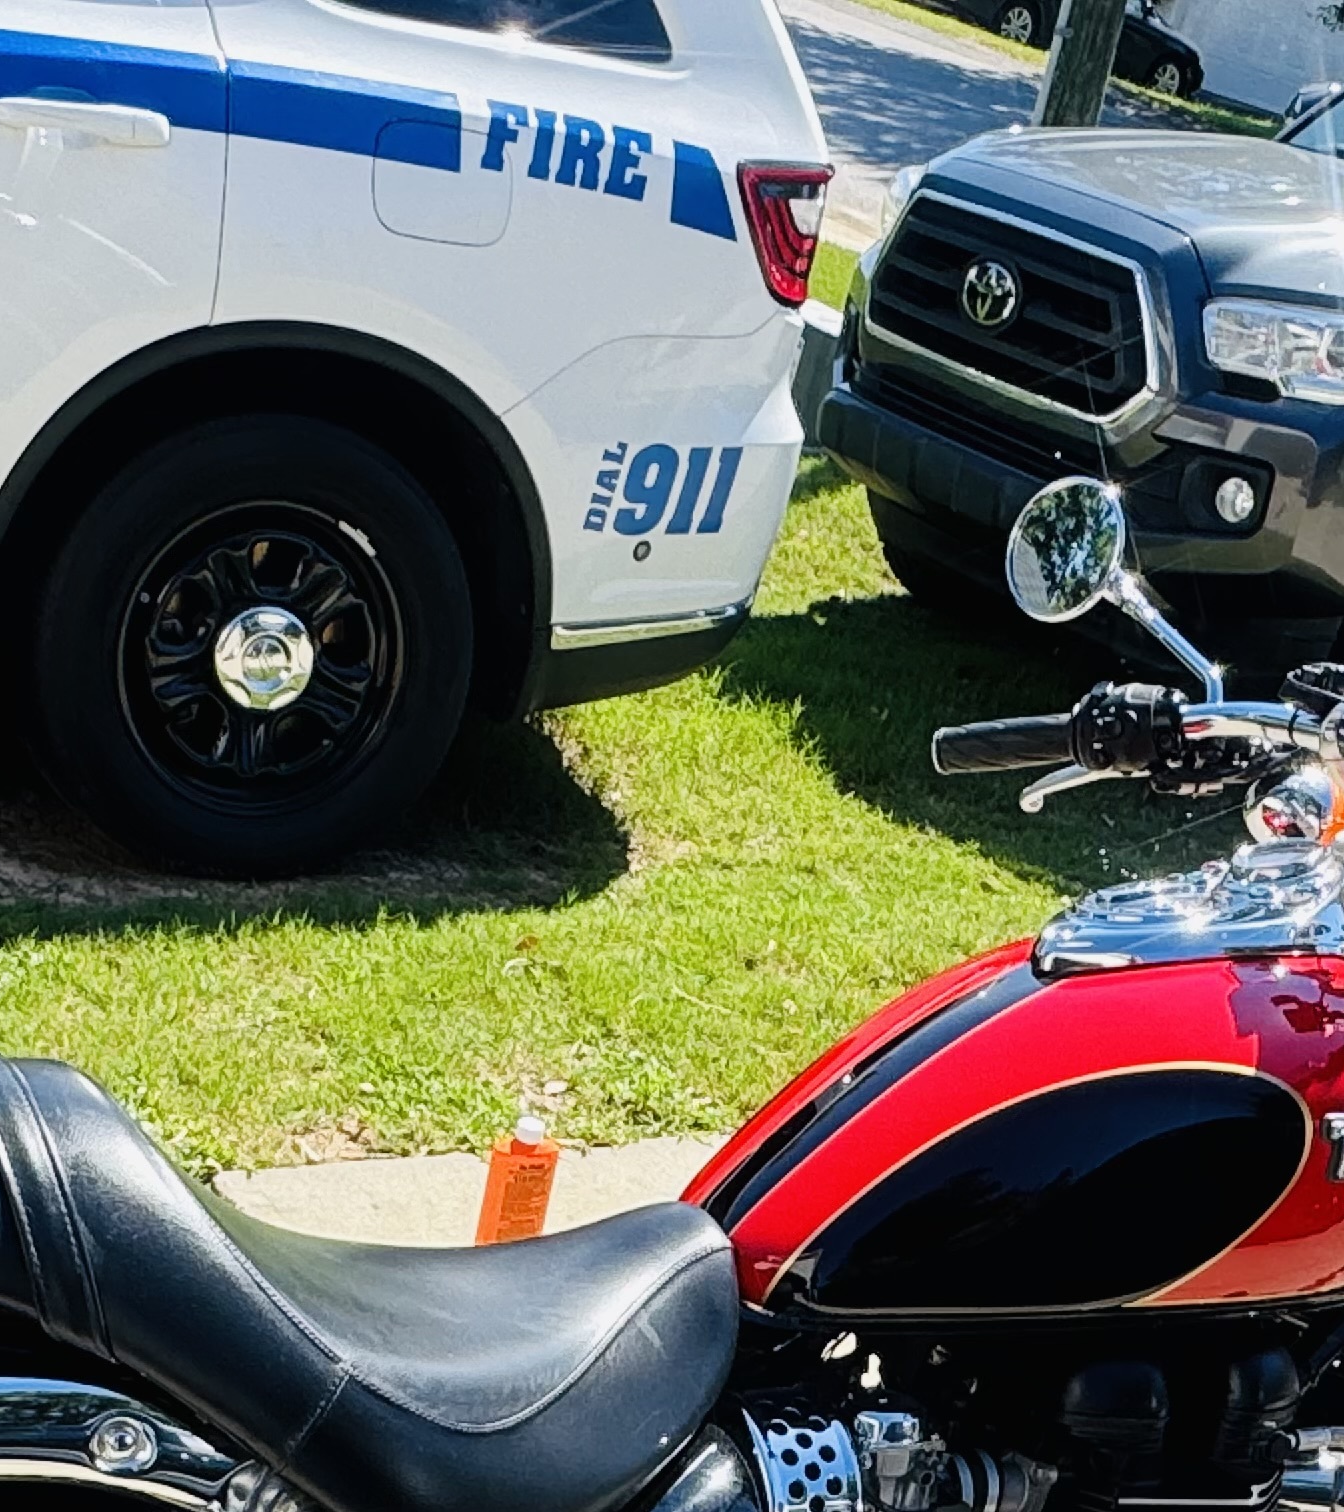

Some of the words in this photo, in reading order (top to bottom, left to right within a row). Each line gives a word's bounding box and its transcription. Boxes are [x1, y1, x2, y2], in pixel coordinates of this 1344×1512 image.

[480, 99, 653, 202] FIRE
[582, 441, 629, 532] DIAL
[613, 442, 744, 536] 911
